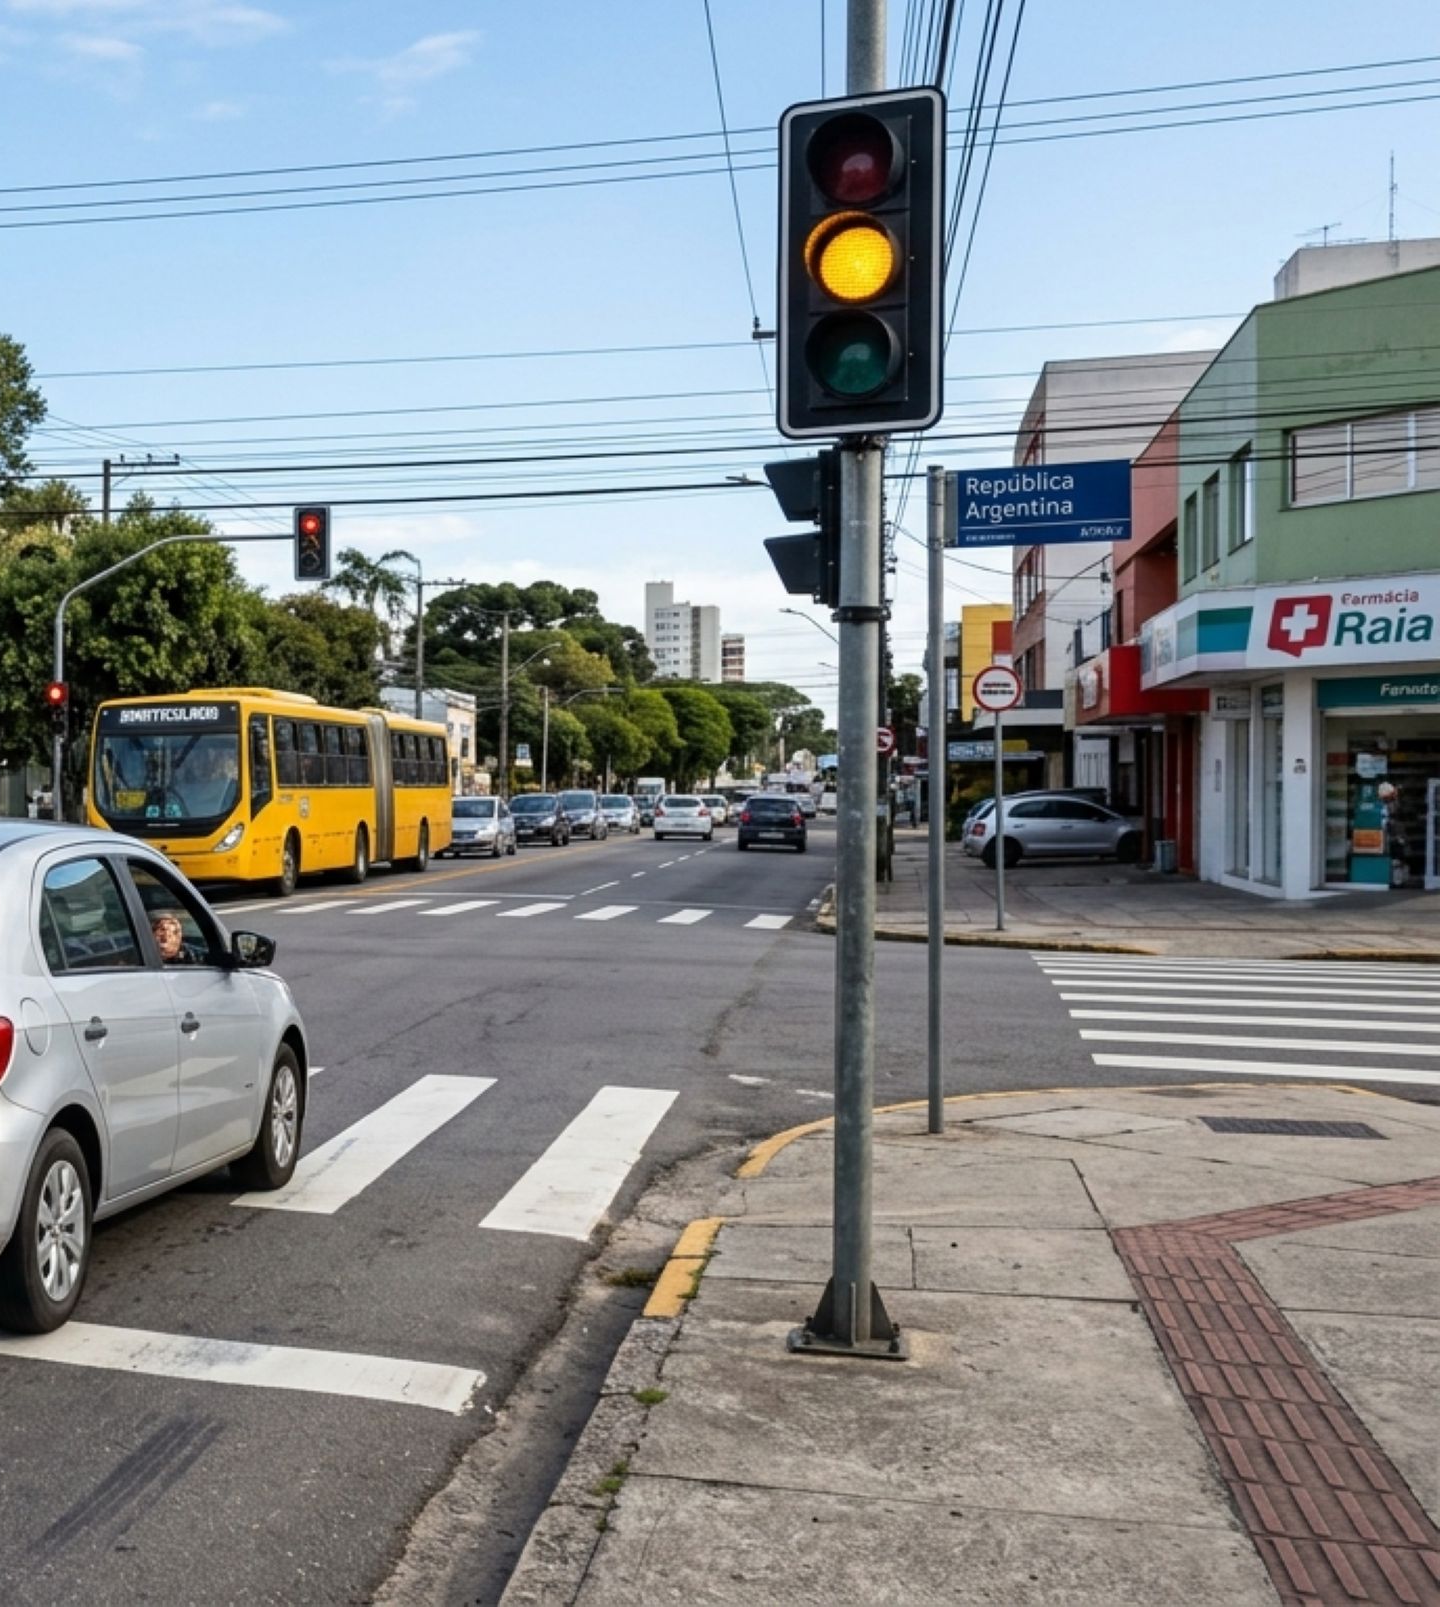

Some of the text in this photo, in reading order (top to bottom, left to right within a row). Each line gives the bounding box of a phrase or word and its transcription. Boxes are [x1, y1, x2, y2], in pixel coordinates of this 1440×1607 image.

[966, 472, 1074, 498] República
[965, 497, 1073, 523] Argentina
[1333, 607, 1435, 646] Raia
